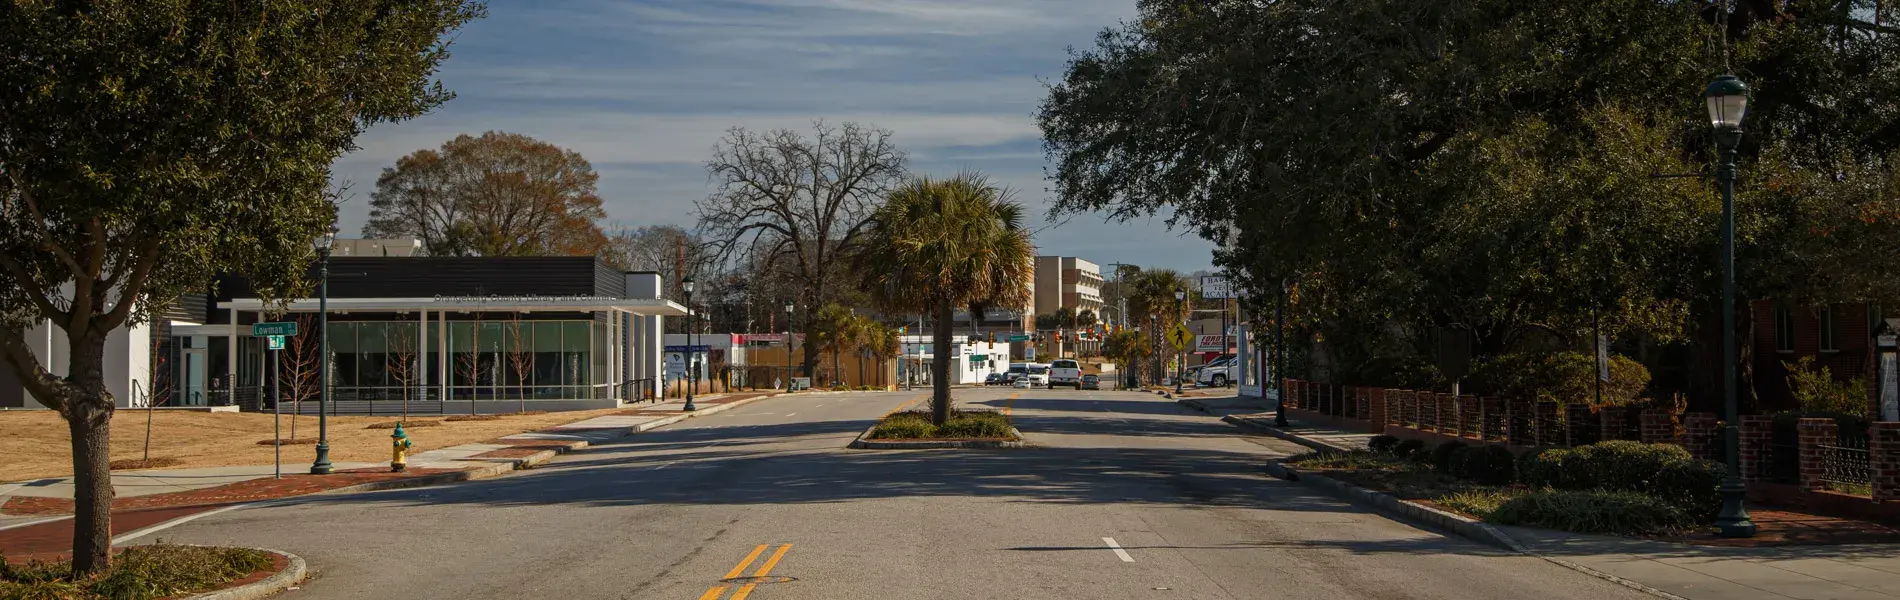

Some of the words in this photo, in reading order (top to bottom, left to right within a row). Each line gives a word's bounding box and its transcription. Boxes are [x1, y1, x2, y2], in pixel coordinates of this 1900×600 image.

[434, 294, 487, 303] Orangeburg
[490, 293, 522, 303] County
[526, 293, 557, 303] Library
[254, 325, 283, 334] Lowman
